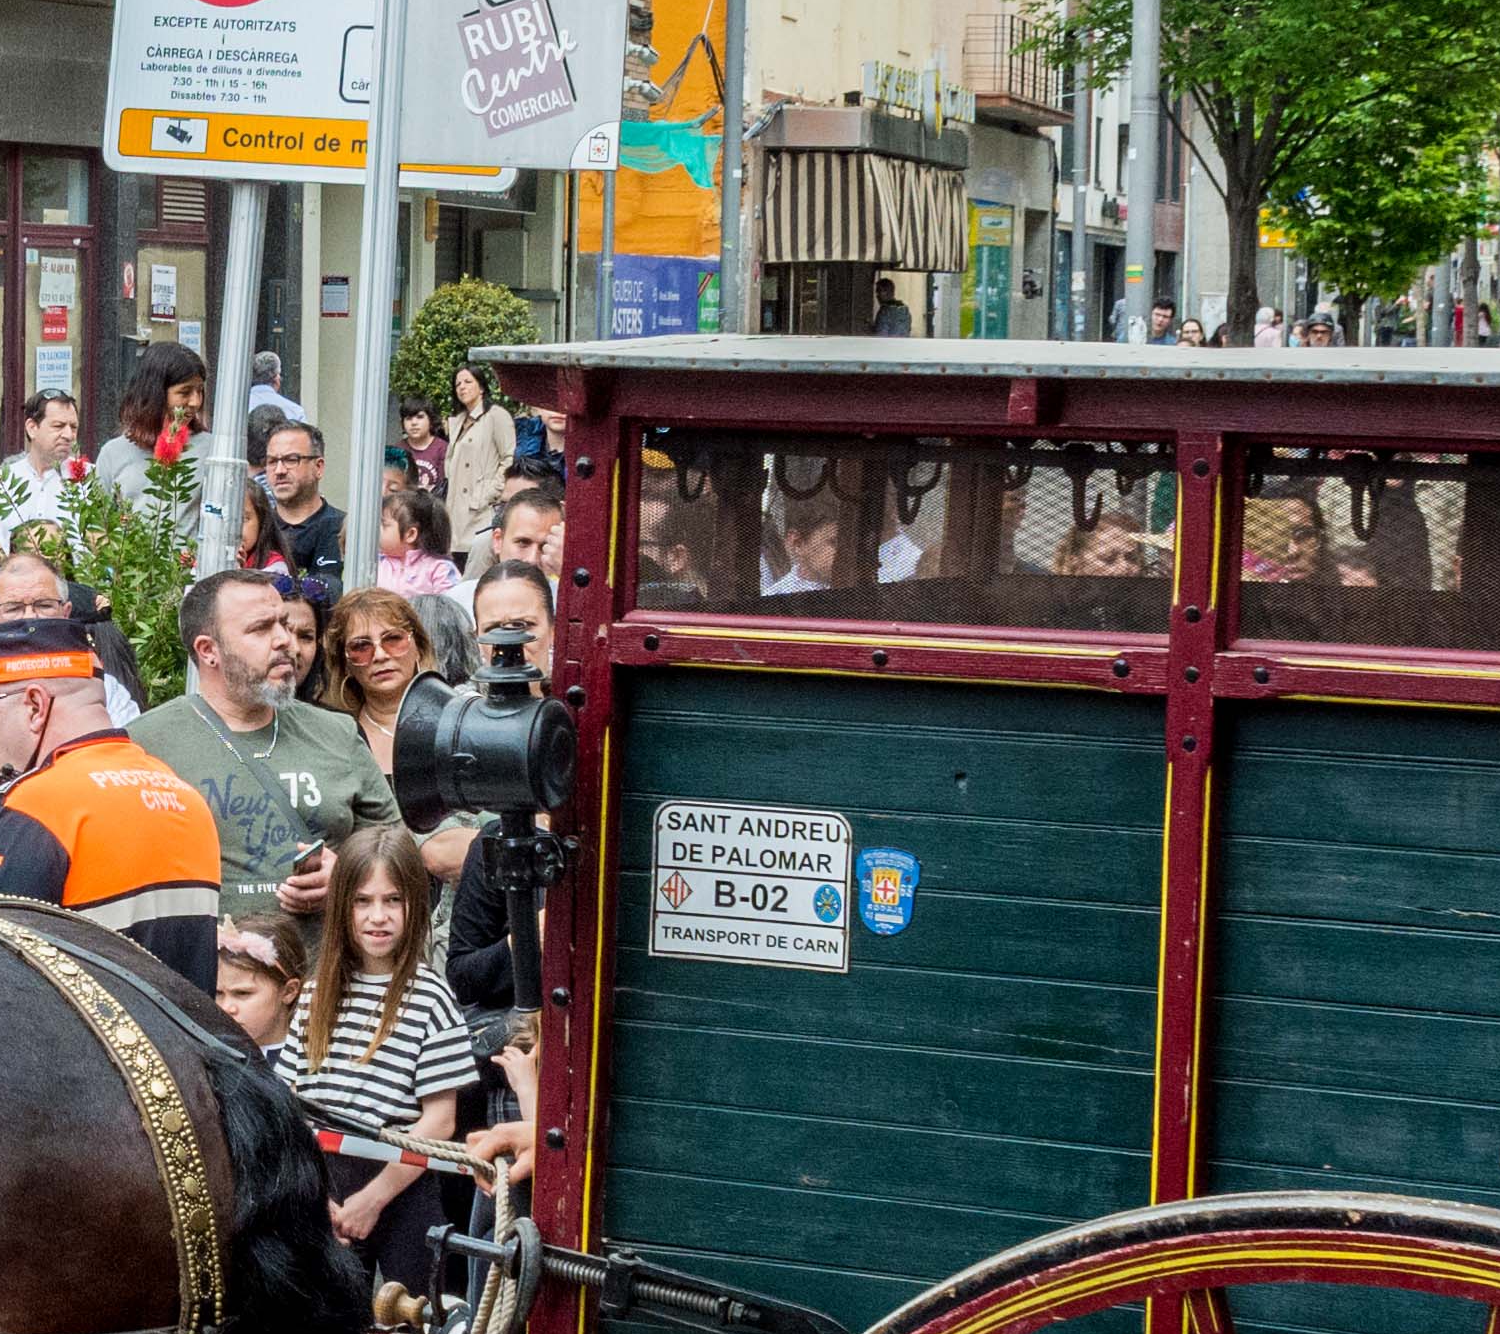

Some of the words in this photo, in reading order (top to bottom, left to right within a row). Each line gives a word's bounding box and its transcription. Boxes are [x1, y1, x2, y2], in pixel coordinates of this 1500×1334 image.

[153, 16, 208, 29] EXCEPTE
[213, 18, 297, 33] AUTORITZATS
[146, 45, 204, 60] CÀRREGA
[216, 47, 299, 64] DESCÀRREGA
[140, 62, 193, 73] Laborables
[196, 64, 209, 74] de
[211, 65, 243, 75] dilluns
[255, 67, 303, 78] divendres
[460, 28, 578, 116] Centre
[172, 77, 193, 86] 7:30
[204, 78, 219, 88] 11h
[229, 79, 239, 89] 15
[252, 80, 268, 91] 16h
[170, 90, 217, 102] Dissables
[220, 93, 241, 103] 7:30
[253, 94, 267, 104] 11h
[488, 87, 569, 130] COMERCIAL
[222, 127, 304, 150] Control
[313, 133, 340, 152] de
[140, 788, 187, 812] CIVIL
[279, 771, 322, 809] 73
[666, 811, 731, 835] SANT
[738, 817, 842, 844] ANDREU
[672, 842, 704, 863] DE
[711, 845, 833, 874] PALOMAR
[237, 884, 255, 894] THE
[257, 883, 278, 893] FIVE
[713, 879, 789, 913] B-02
[661, 925, 761, 947] TRANSPORT
[766, 934, 788, 950] DE
[792, 937, 839, 954] CARN
